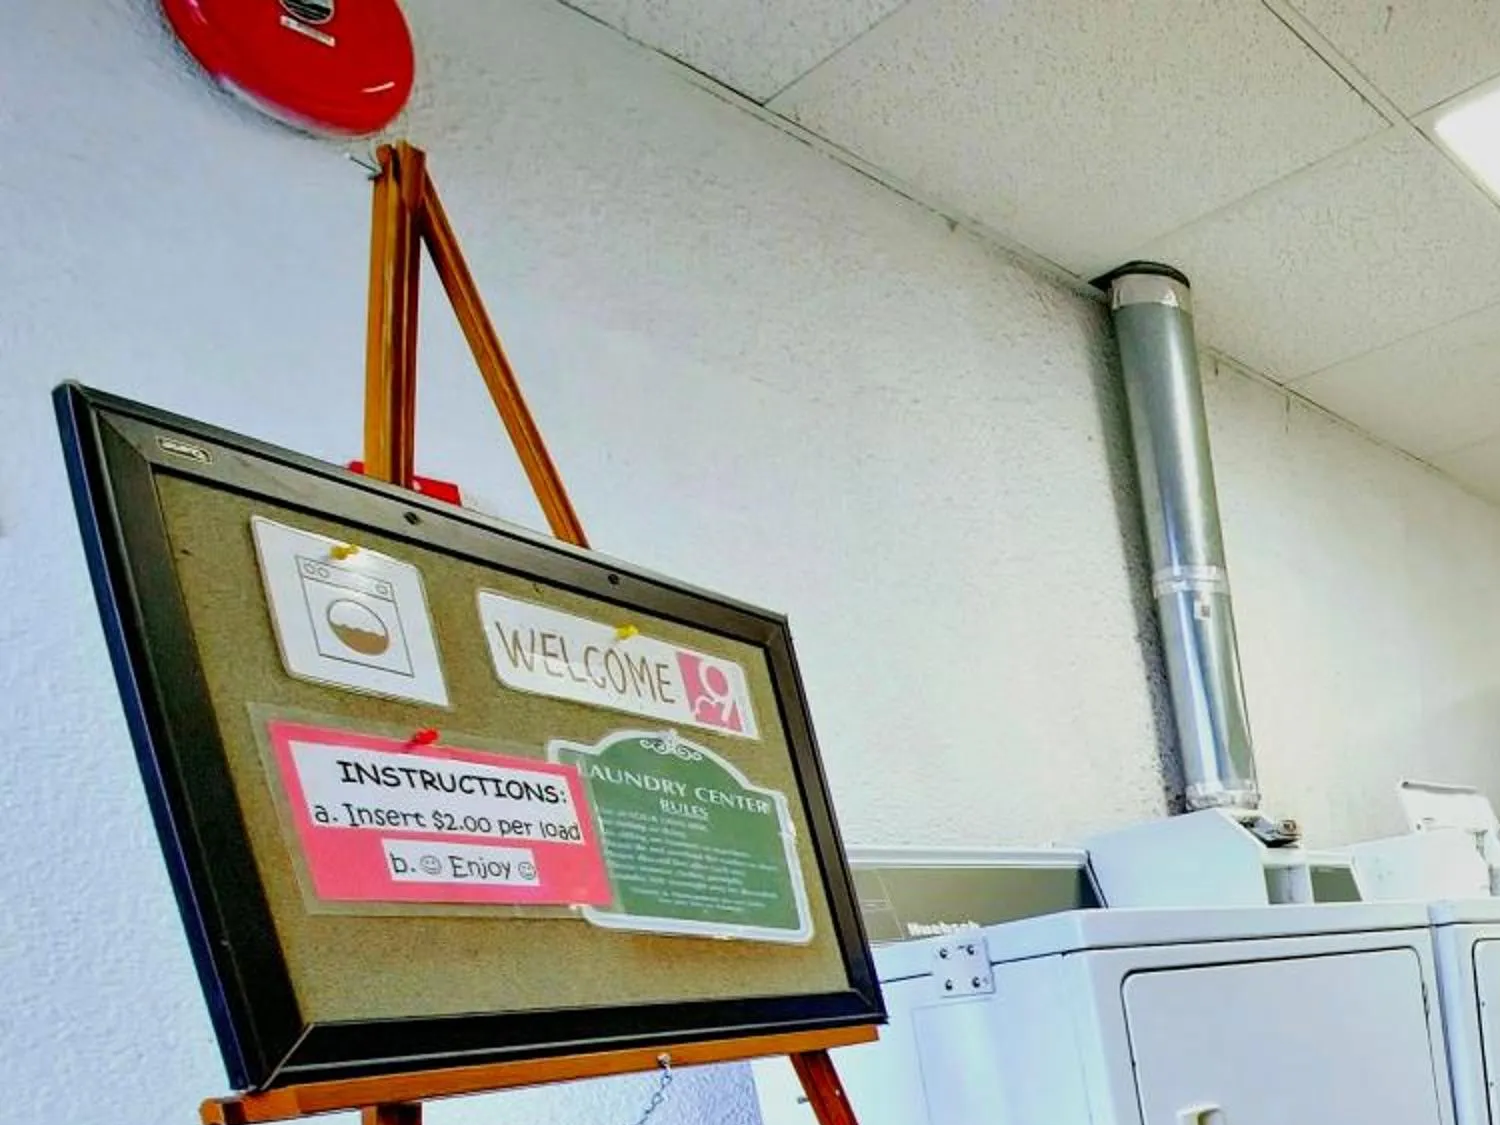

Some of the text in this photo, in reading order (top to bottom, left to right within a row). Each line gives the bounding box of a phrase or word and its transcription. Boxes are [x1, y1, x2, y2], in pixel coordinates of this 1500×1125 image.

[494, 620, 676, 704] WELCOME
[336, 760, 568, 804] INSTRUCTIONS:
[659, 798, 710, 819] RULES
[695, 786, 771, 815] CENTER
[314, 803, 582, 842] a. Insert $2.00 per load
[390, 852, 512, 881] b. Enjoy
